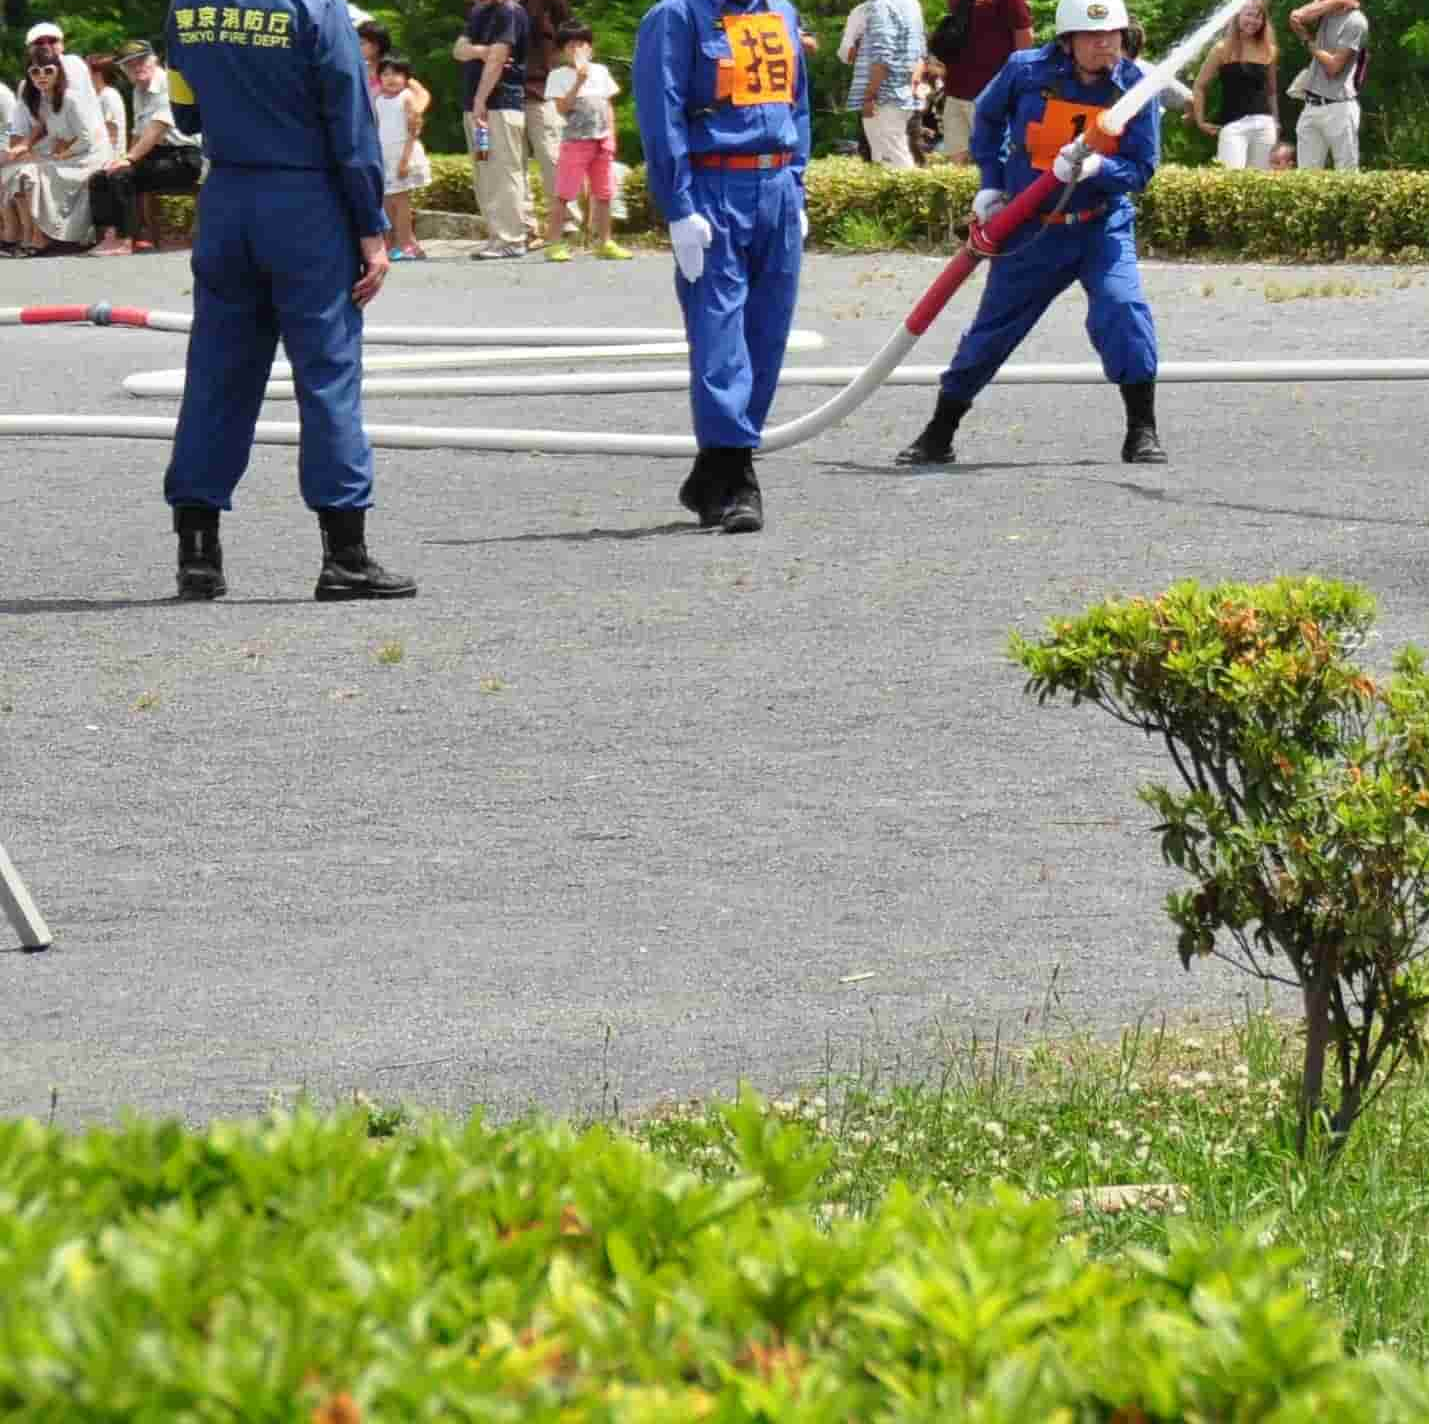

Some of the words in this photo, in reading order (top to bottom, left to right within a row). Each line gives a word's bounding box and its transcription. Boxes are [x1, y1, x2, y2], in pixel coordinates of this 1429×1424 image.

[175, 7, 289, 34] 東京消防庁
[220, 31, 247, 46] FIRE
[740, 29, 788, 94] 指
